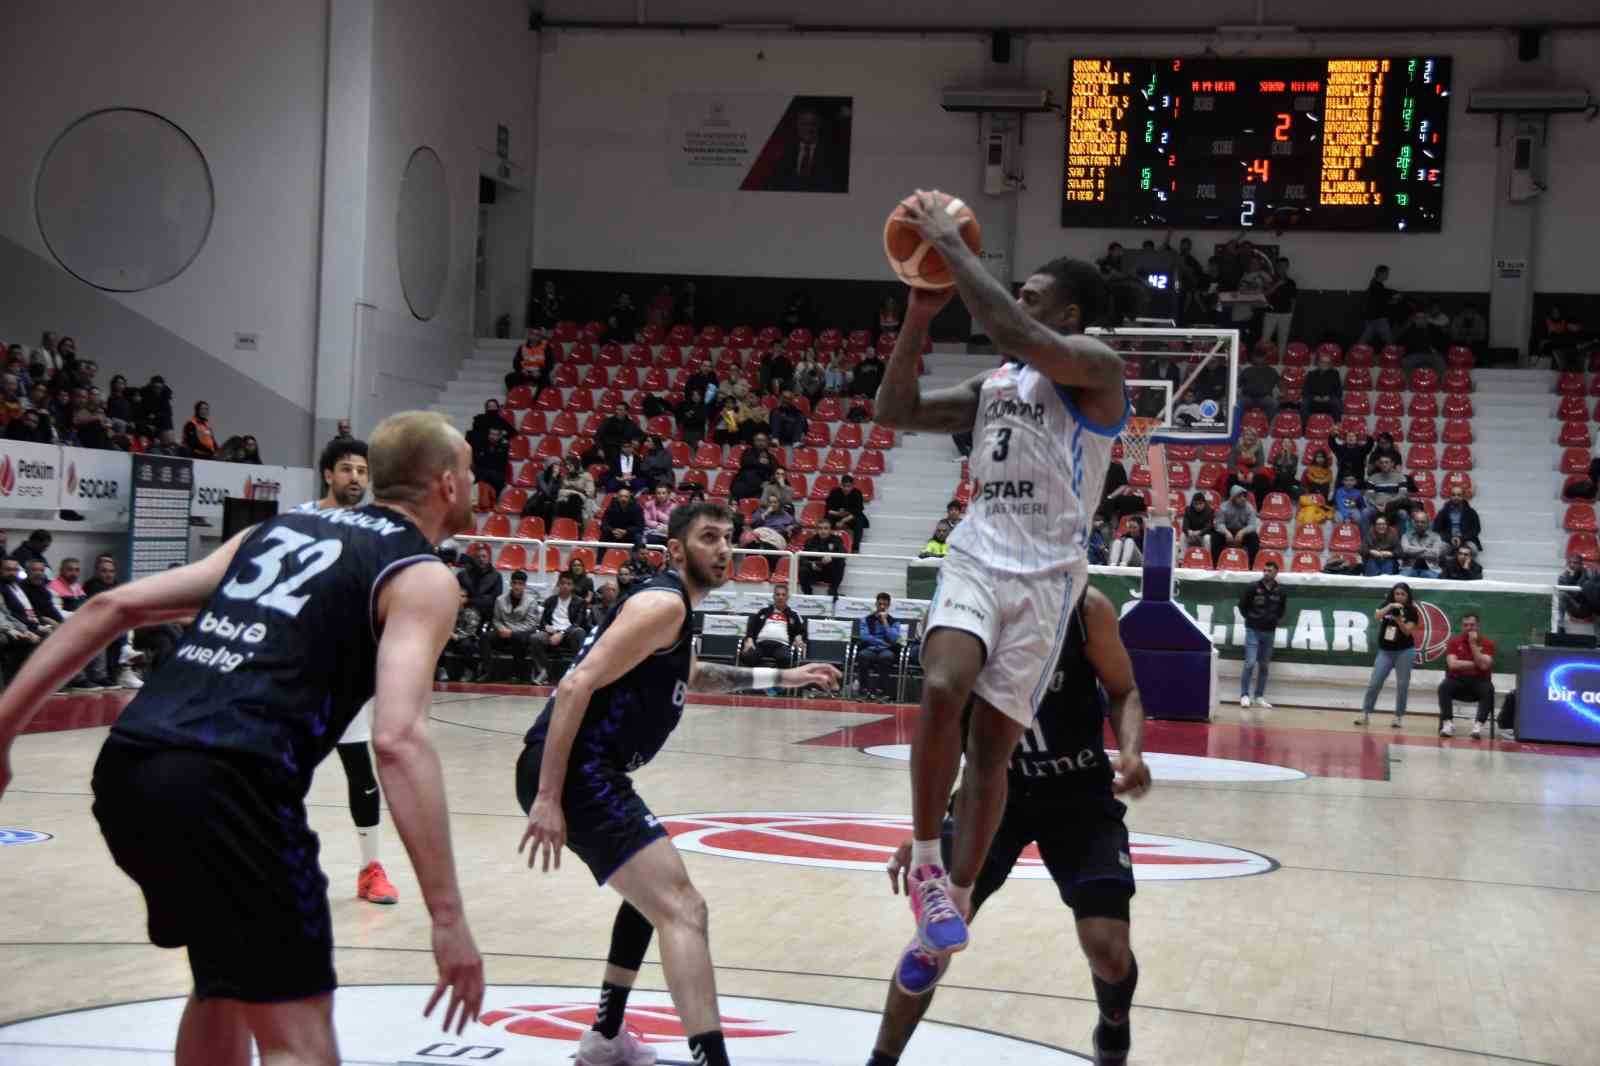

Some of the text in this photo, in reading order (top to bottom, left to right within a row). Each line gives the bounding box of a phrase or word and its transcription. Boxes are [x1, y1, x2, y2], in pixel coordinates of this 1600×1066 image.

[1275, 113, 1292, 141] 2
[1240, 200, 1255, 226] 2
[1147, 273, 1168, 289] 42
[992, 427, 1012, 462] 3
[79, 478, 119, 499] SOCAR
[984, 480, 1034, 501] STAR
[223, 526, 342, 618] 32
[1547, 685, 1576, 702] bir
